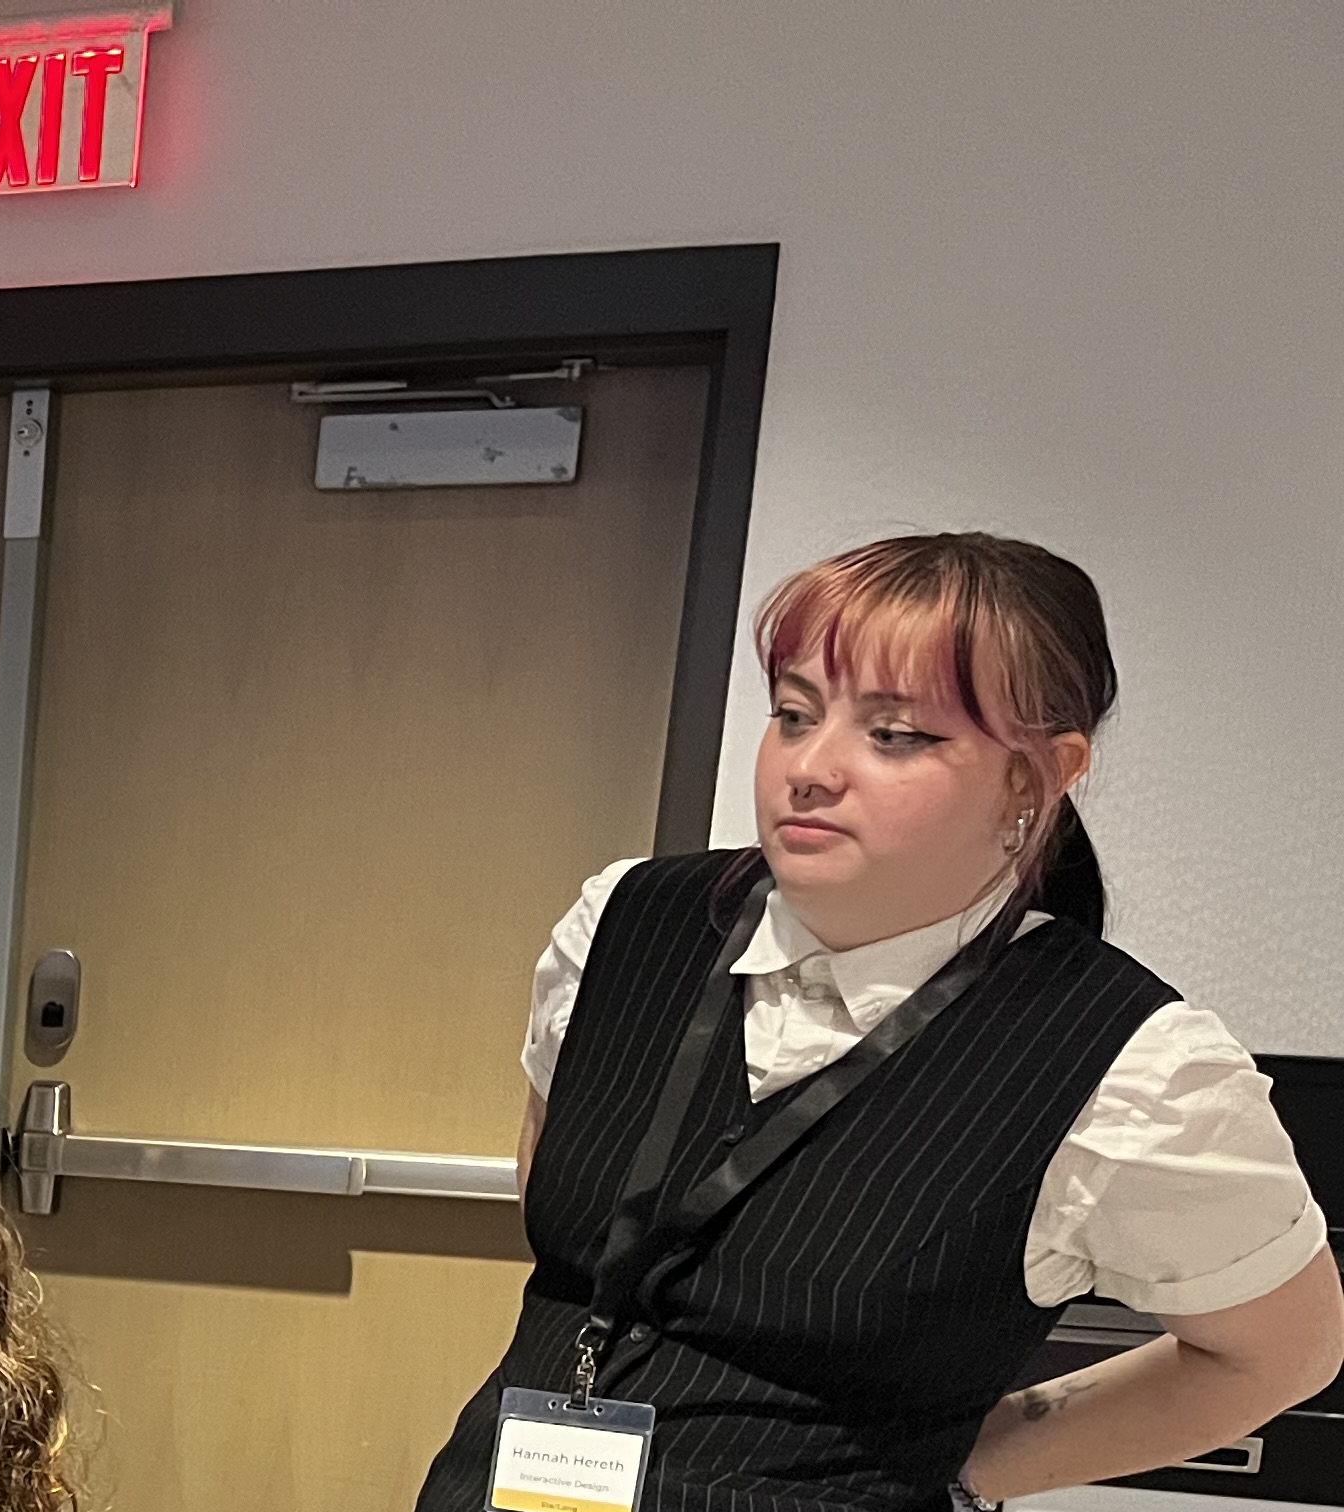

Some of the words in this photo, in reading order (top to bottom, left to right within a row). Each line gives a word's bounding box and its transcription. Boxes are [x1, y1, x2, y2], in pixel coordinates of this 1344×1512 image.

[512, 1447, 569, 1465] Hannah
[573, 1455, 624, 1472] Hereth
[519, 1472, 572, 1487] Interactive
[574, 1480, 609, 1492] Design
